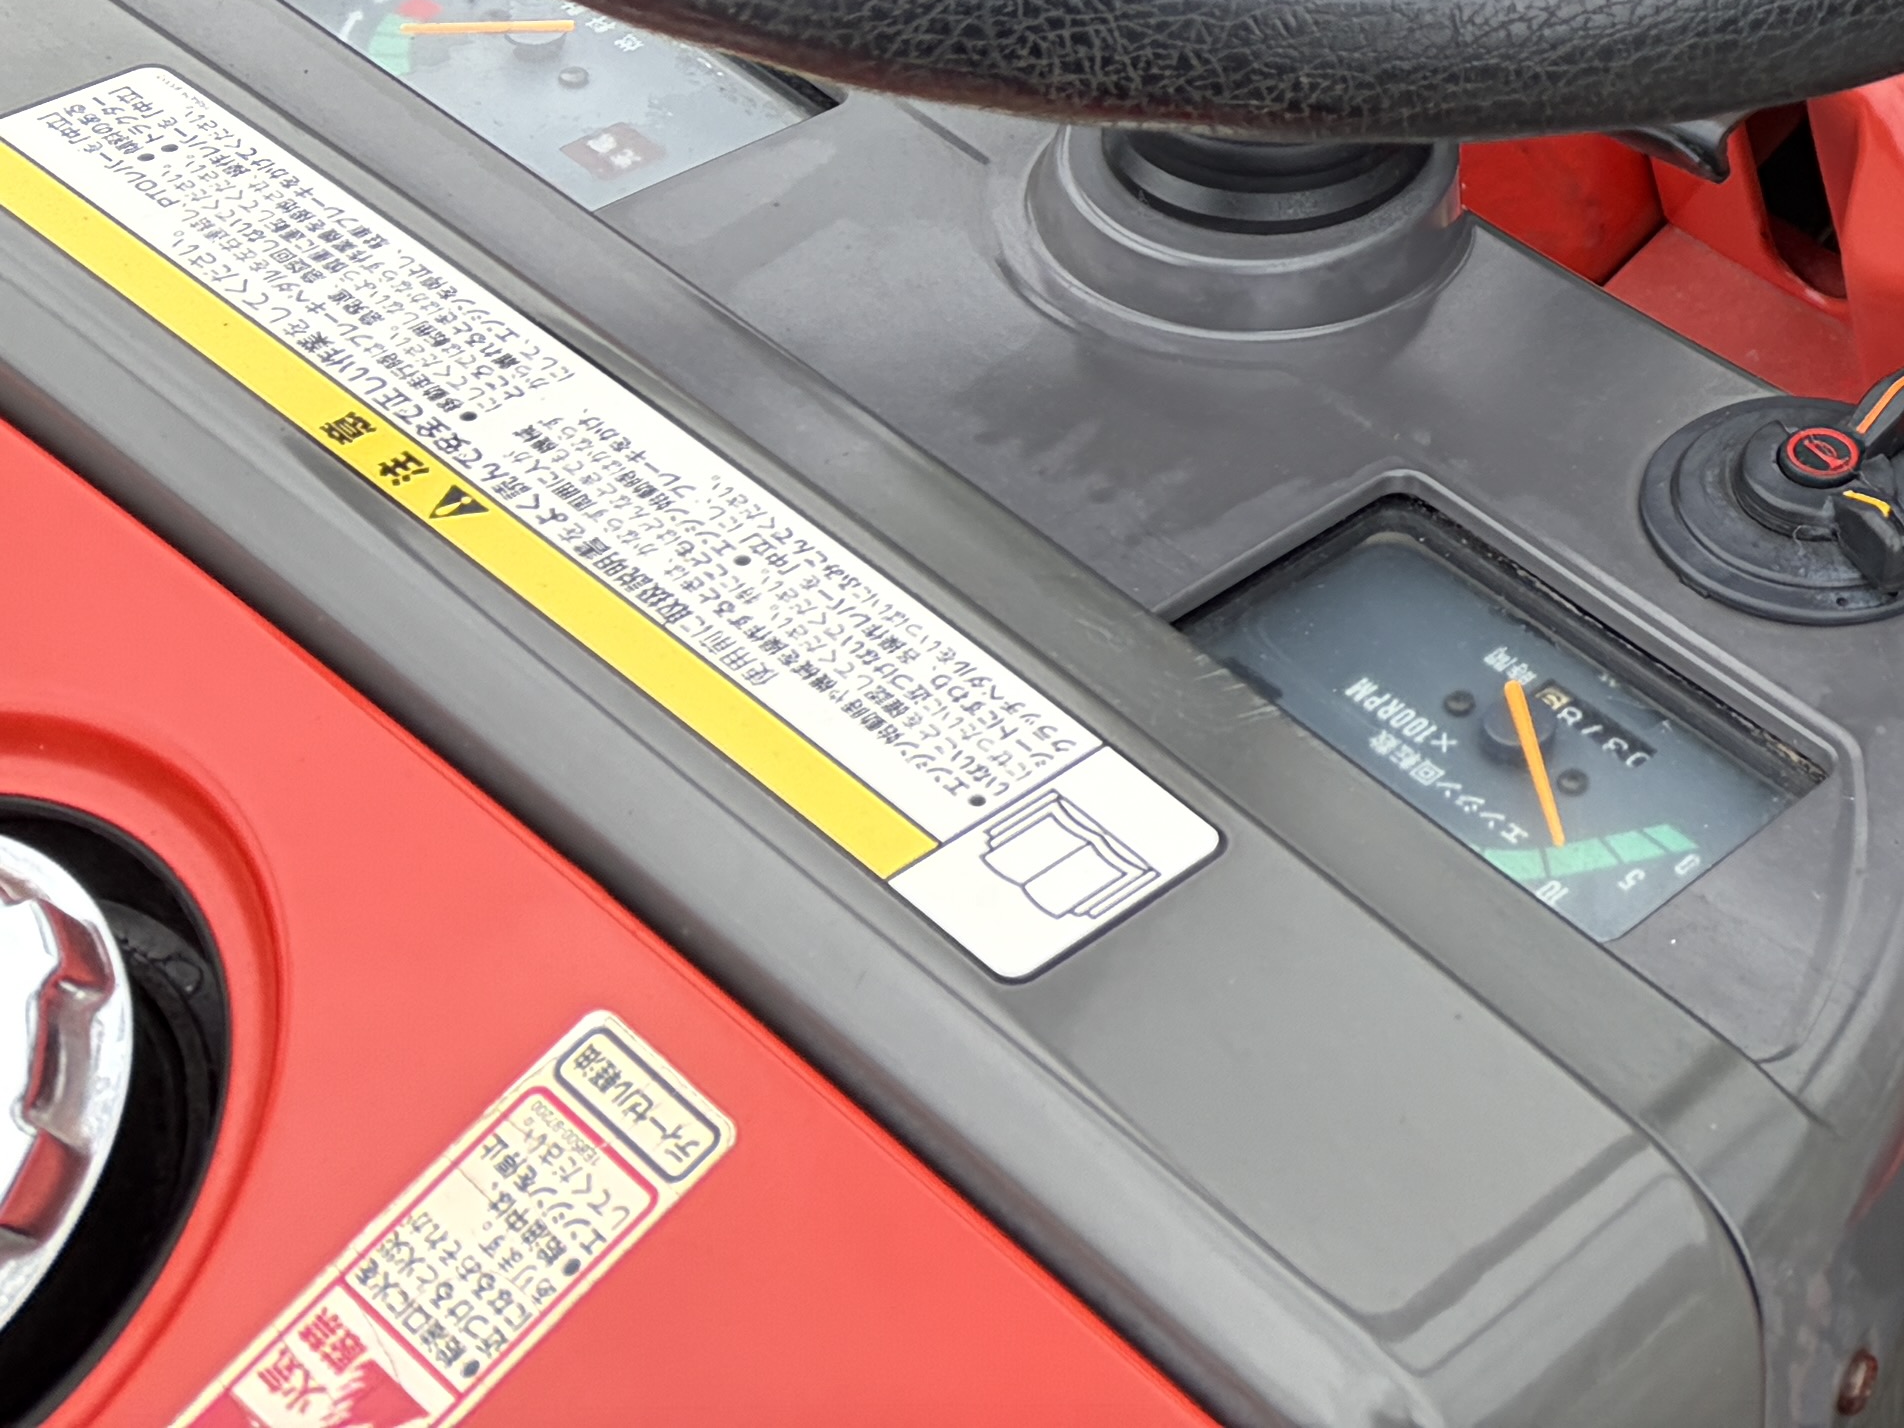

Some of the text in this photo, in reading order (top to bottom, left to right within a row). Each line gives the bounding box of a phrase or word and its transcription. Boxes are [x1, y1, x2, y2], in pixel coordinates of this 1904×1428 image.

[154, 228, 782, 687] 使用前に取扱説明書をよく読んで安全で正しい作業をしてください。
[315, 410, 435, 486] 注意
[1536, 880, 1570, 905] 10
[1618, 868, 1645, 892] 5
[567, 1041, 703, 1166] ディーゼル軽油
[473, 1131, 609, 1257] エンジンを停止
[507, 1113, 634, 1230] してください。
[468, 1217, 561, 1308] あります。
[475, 1178, 571, 1266] 給油中は、
[373, 1229, 512, 1358] 近づけると火災
[397, 1205, 534, 1332] になるおそれが
[249, 1343, 328, 1417] 火気
[293, 1305, 371, 1376] 厳禁
